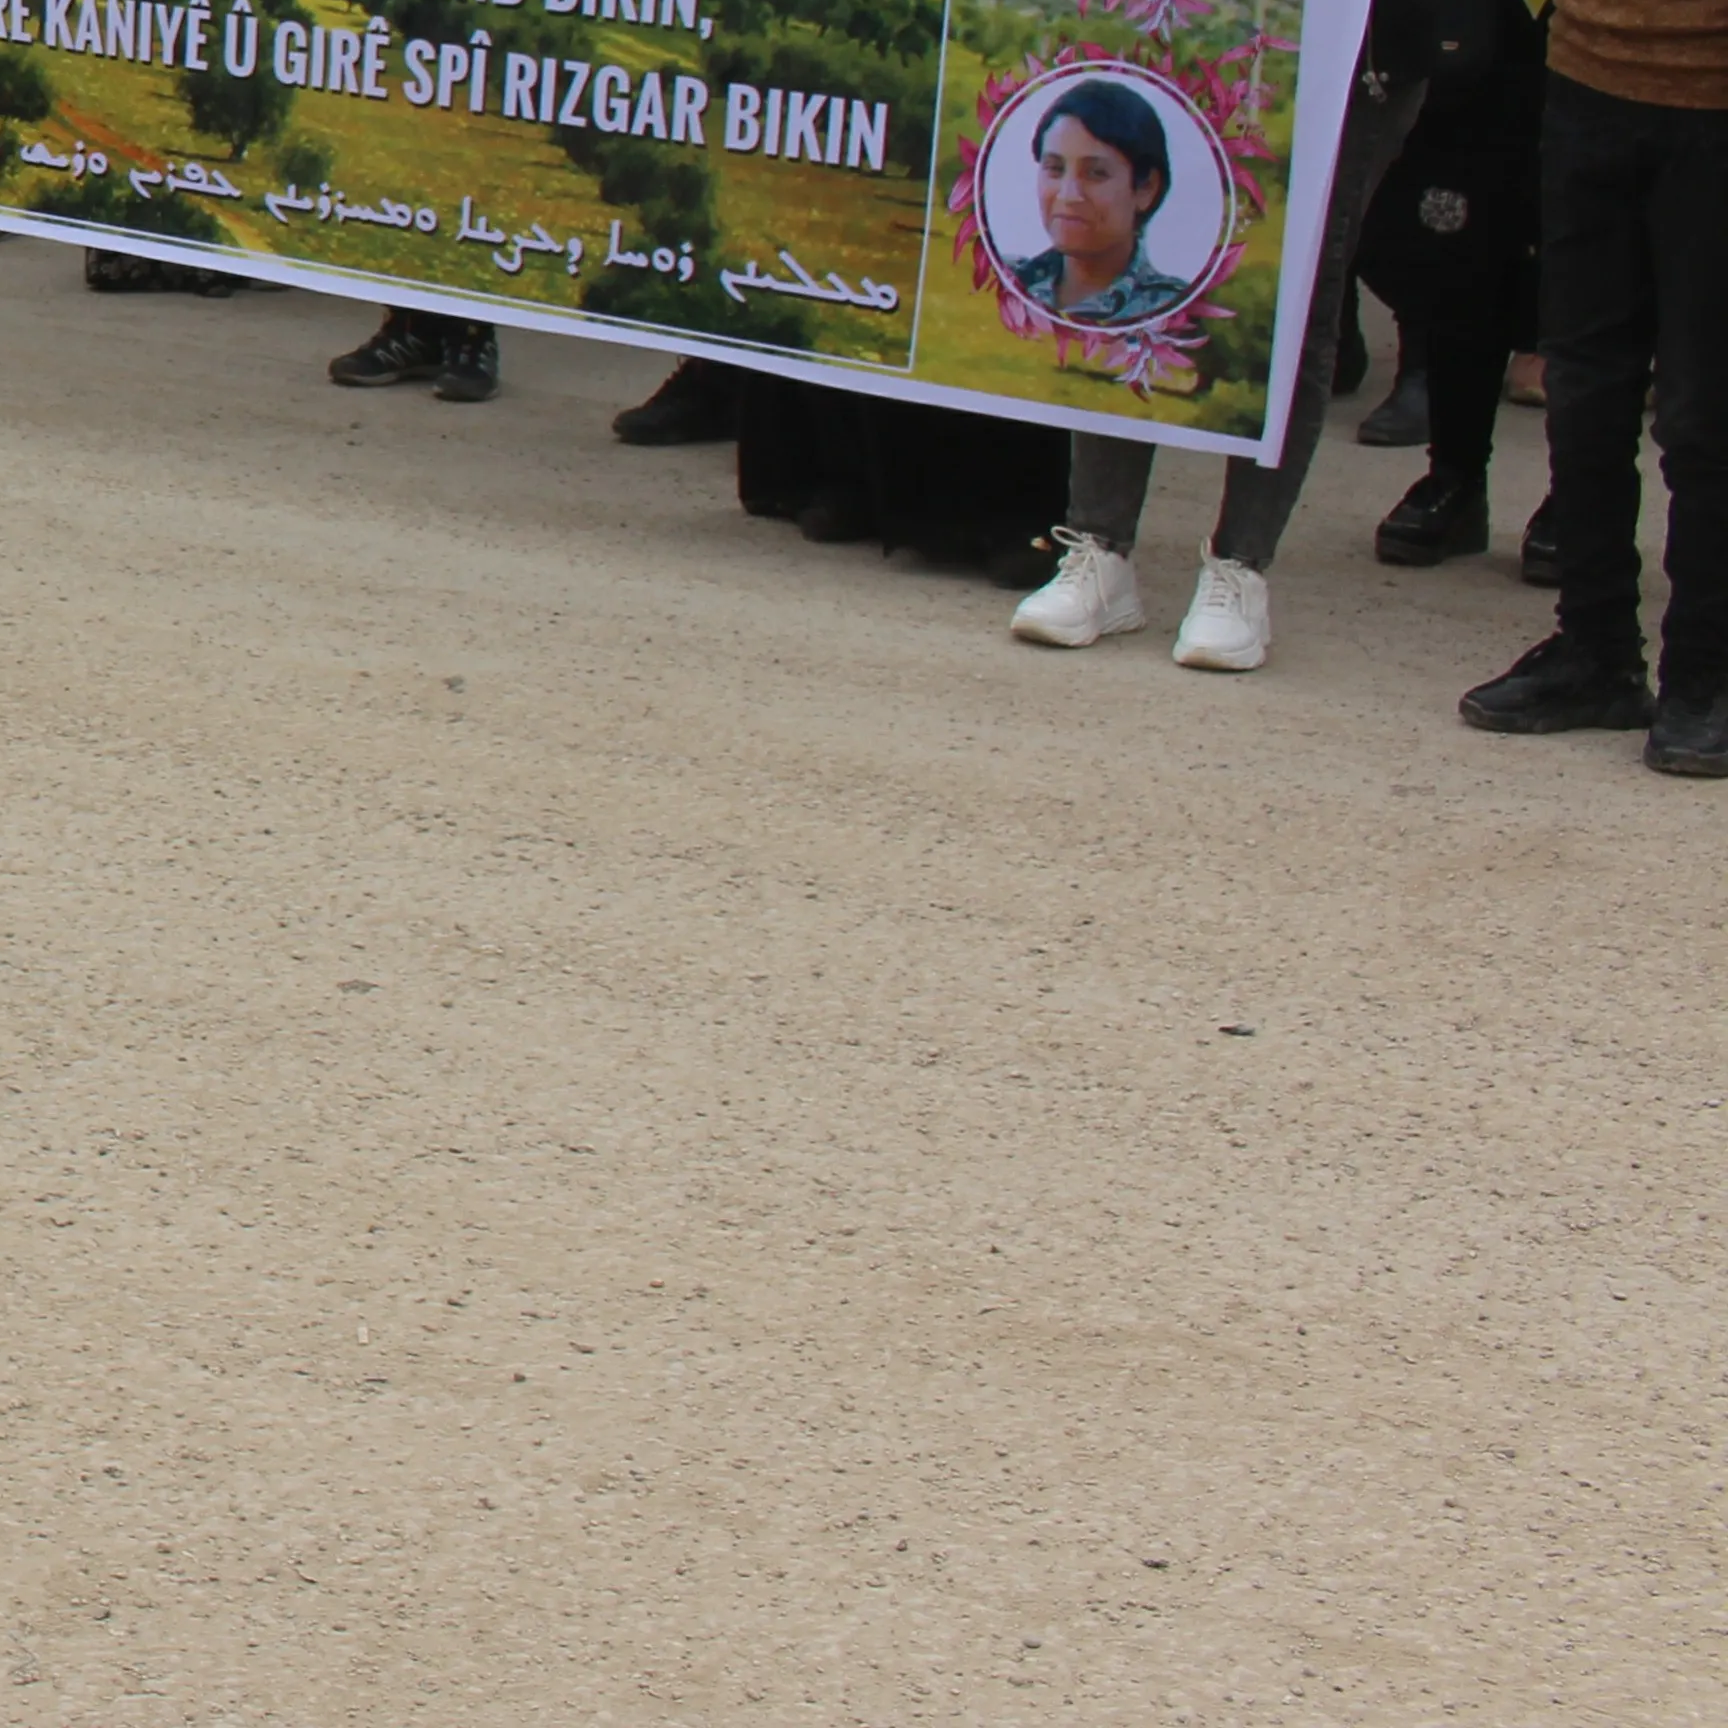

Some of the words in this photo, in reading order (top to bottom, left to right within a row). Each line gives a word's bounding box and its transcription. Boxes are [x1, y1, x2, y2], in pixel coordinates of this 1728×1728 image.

[274, 15, 392, 99] GIRÊ
[402, 29, 493, 113] SPÎ
[503, 52, 709, 146] RIZGAR
[724, 83, 889, 172] BIKIN
